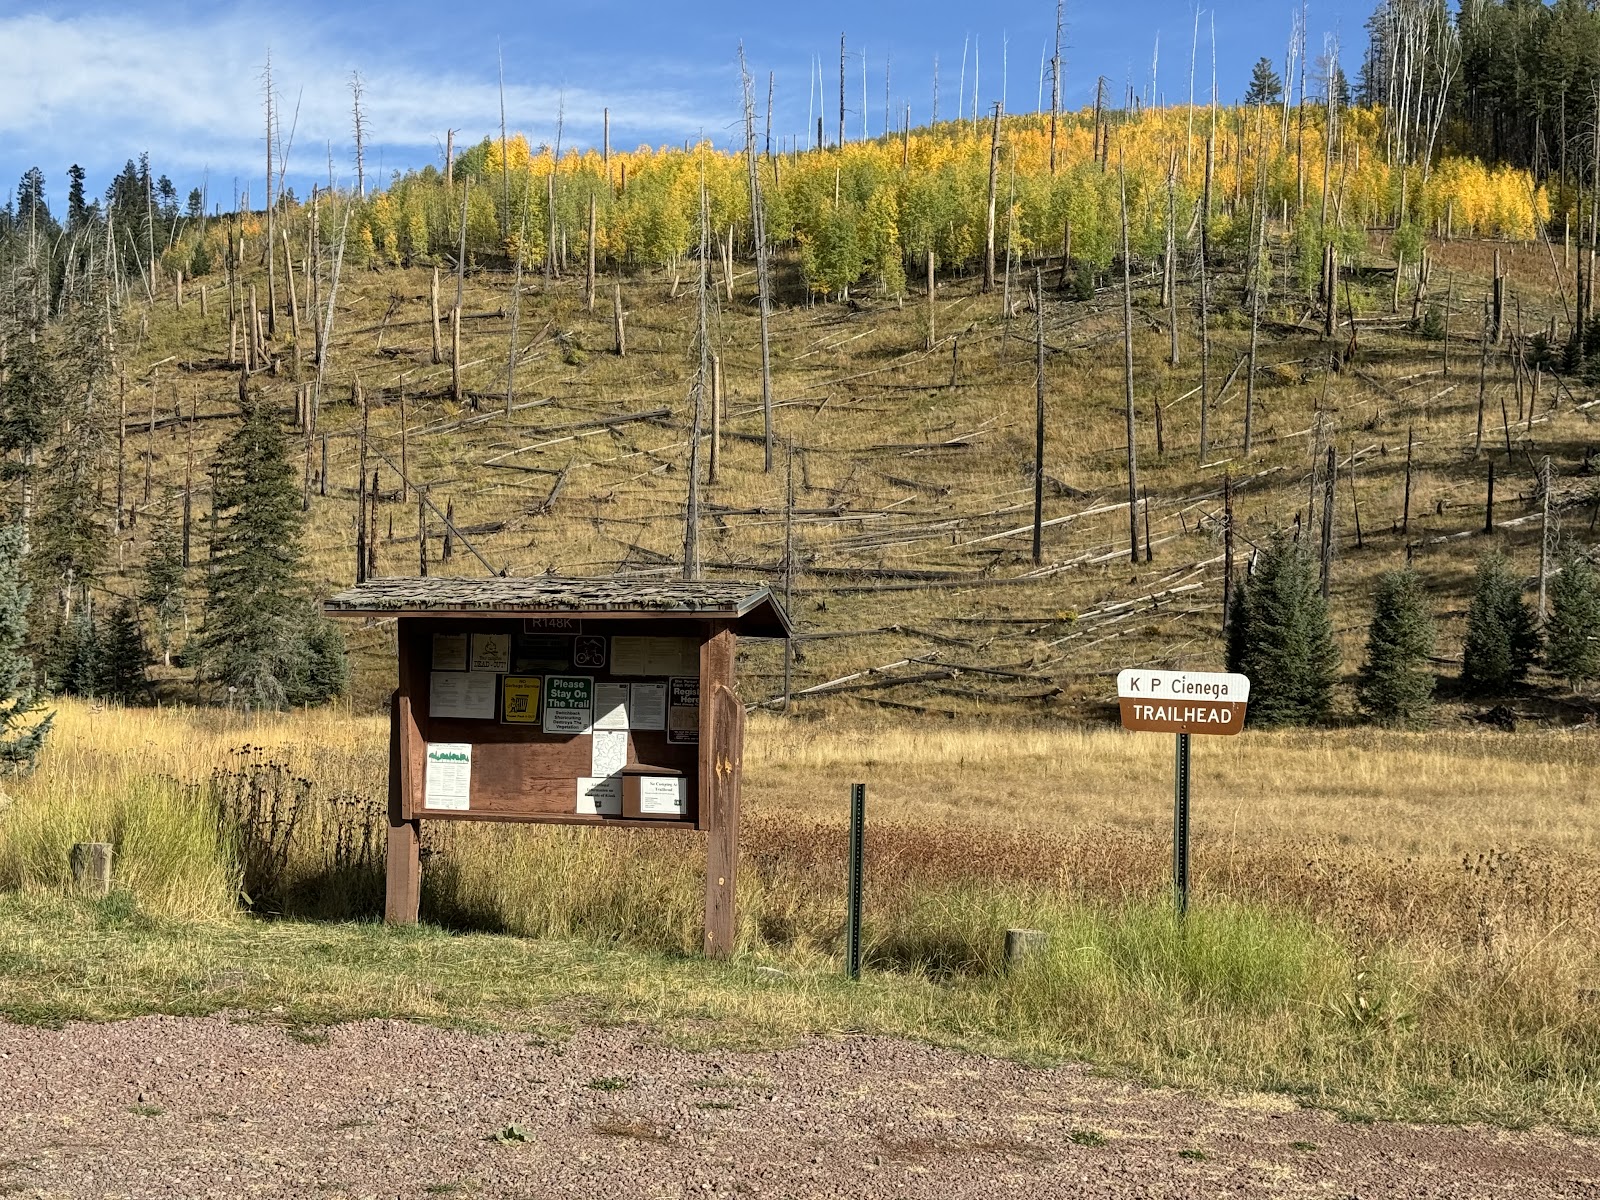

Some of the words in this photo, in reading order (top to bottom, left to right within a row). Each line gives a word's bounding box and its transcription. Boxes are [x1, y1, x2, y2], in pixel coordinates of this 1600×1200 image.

[553, 679, 585, 689] Please
[1130, 677, 1141, 692] K
[1151, 678, 1162, 692] P
[1171, 677, 1229, 699] Cienega
[550, 689, 572, 699] Stay
[574, 690, 587, 698] On
[547, 698, 566, 708] The
[568, 699, 590, 708] Trail
[1133, 705, 1232, 724] TRAILHEAD
